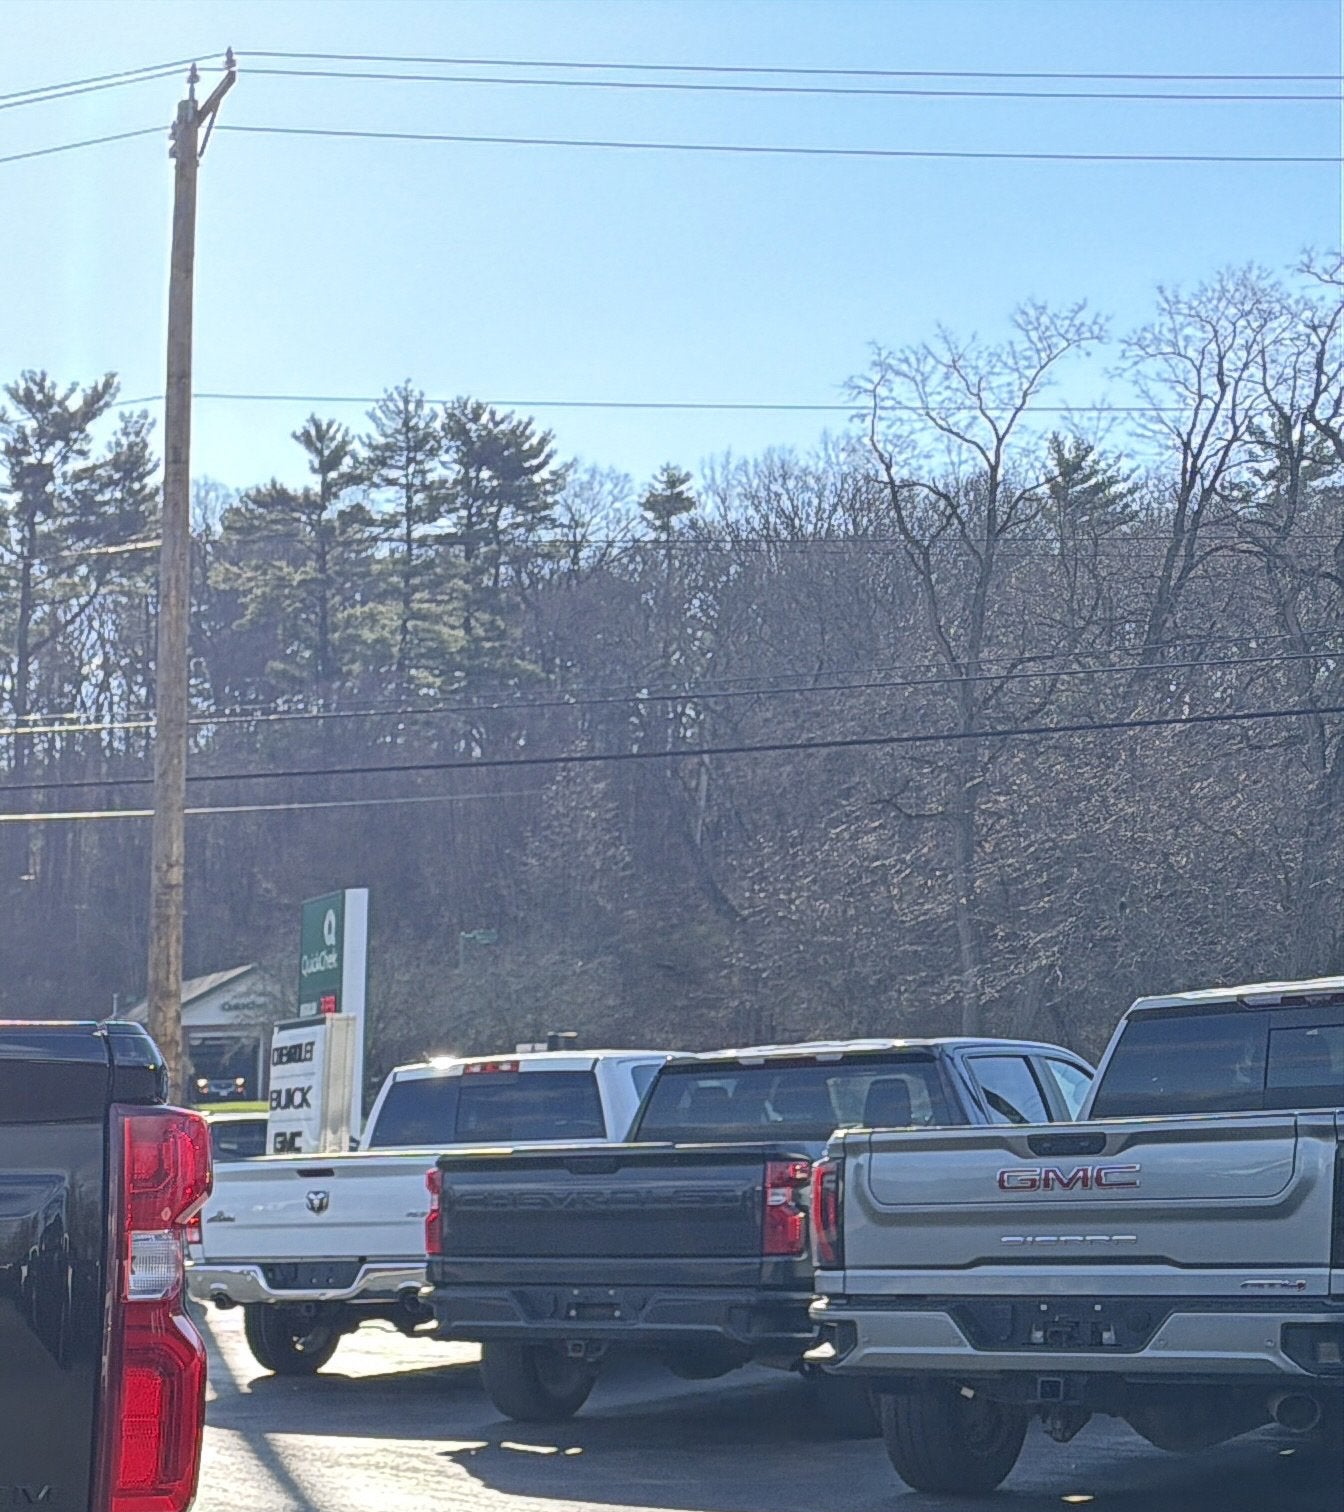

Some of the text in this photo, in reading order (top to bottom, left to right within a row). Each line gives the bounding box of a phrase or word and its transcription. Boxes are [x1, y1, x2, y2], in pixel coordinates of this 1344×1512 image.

[272, 1041, 315, 1066] CHEVROLET
[270, 1085, 312, 1111] BUICK
[273, 1131, 302, 1153] GMC
[997, 1164, 1140, 1192] GMC
